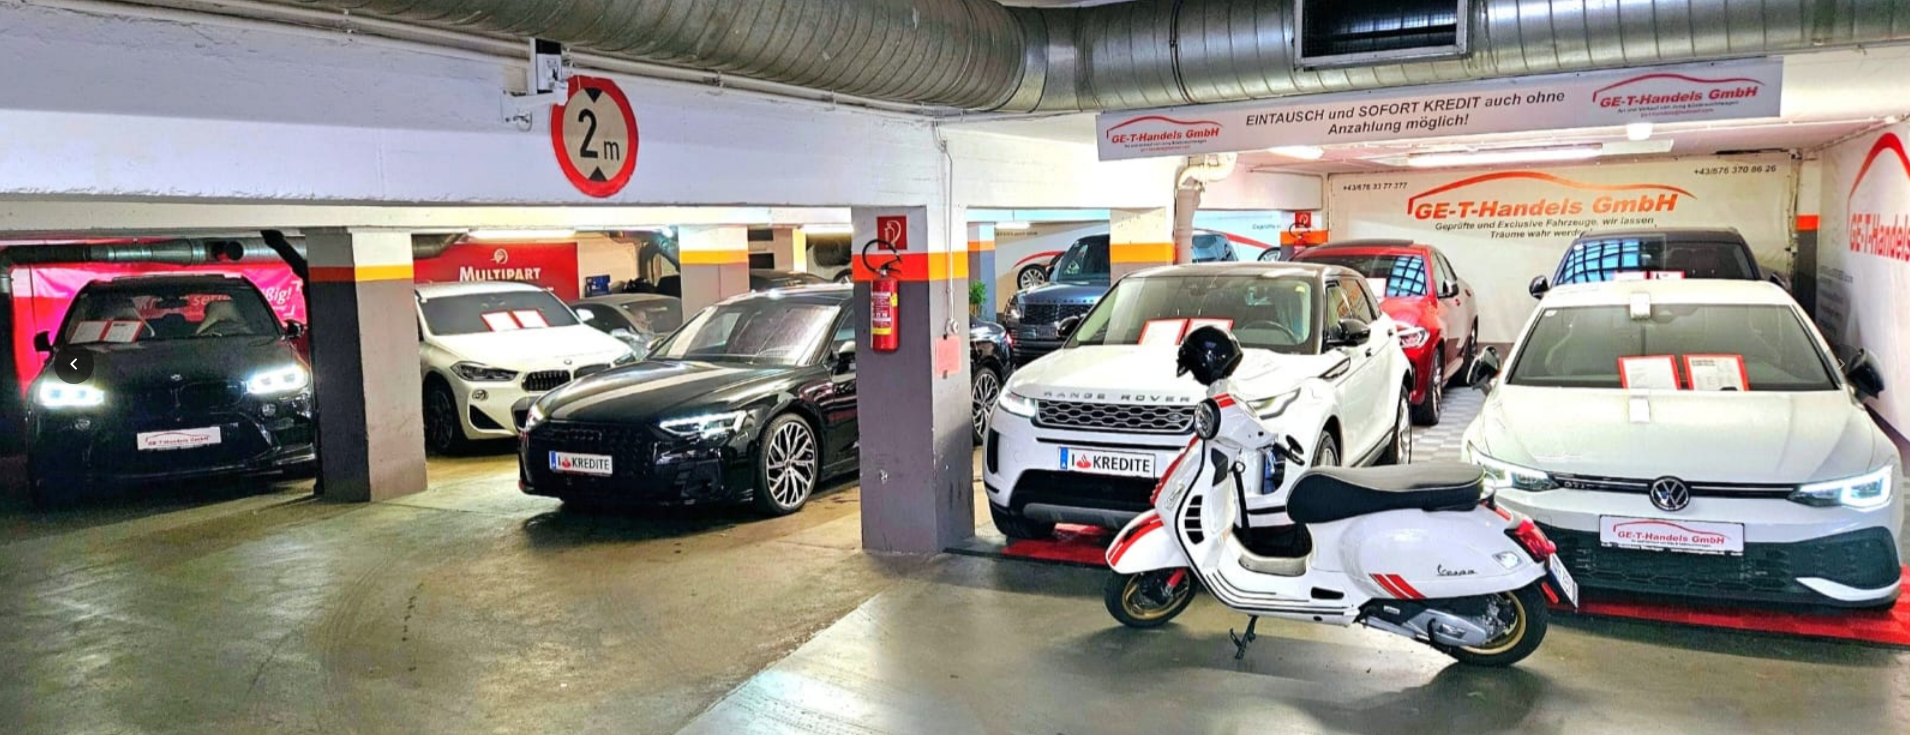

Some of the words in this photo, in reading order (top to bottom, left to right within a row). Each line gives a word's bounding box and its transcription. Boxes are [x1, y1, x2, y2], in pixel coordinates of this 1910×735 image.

[1600, 90, 1702, 108] GE-T-Handels
[1708, 86, 1758, 100] GmbH
[1246, 109, 1325, 126] EINTAUSCH
[1328, 107, 1354, 120] und
[1358, 102, 1420, 117] SOFORT
[1423, 96, 1482, 112] KREDIT
[1485, 93, 1521, 107] auch
[1526, 91, 1565, 104] ohne
[1328, 120, 1401, 135] Anzahlung
[1406, 114, 1469, 131] möglich!
[578, 108, 598, 159] 2
[603, 141, 620, 160] m
[1111, 130, 1182, 143] GE-T-Handels
[1185, 127, 1219, 138] GmbH
[1731, 165, 1749, 174] 370
[1414, 198, 1583, 220] GE-T-Handels
[1592, 193, 1679, 214] GmbH
[1435, 221, 1475, 231] Geprüfte
[1477, 220, 1495, 229] und
[1497, 219, 1543, 229] Exclusive
[1602, 217, 1619, 225] wir
[1491, 229, 1525, 238] Träume
[1528, 230, 1551, 238] wahr
[459, 266, 541, 282] MULTIPART
[1044, 391, 1106, 400] RANGE
[1120, 394, 1191, 403] ROVER
[572, 456, 610, 471] KREDITE
[1093, 455, 1150, 473] KREDITE
[1617, 530, 1688, 543] GE-T-Handels
[1691, 534, 1725, 545] GmbH
